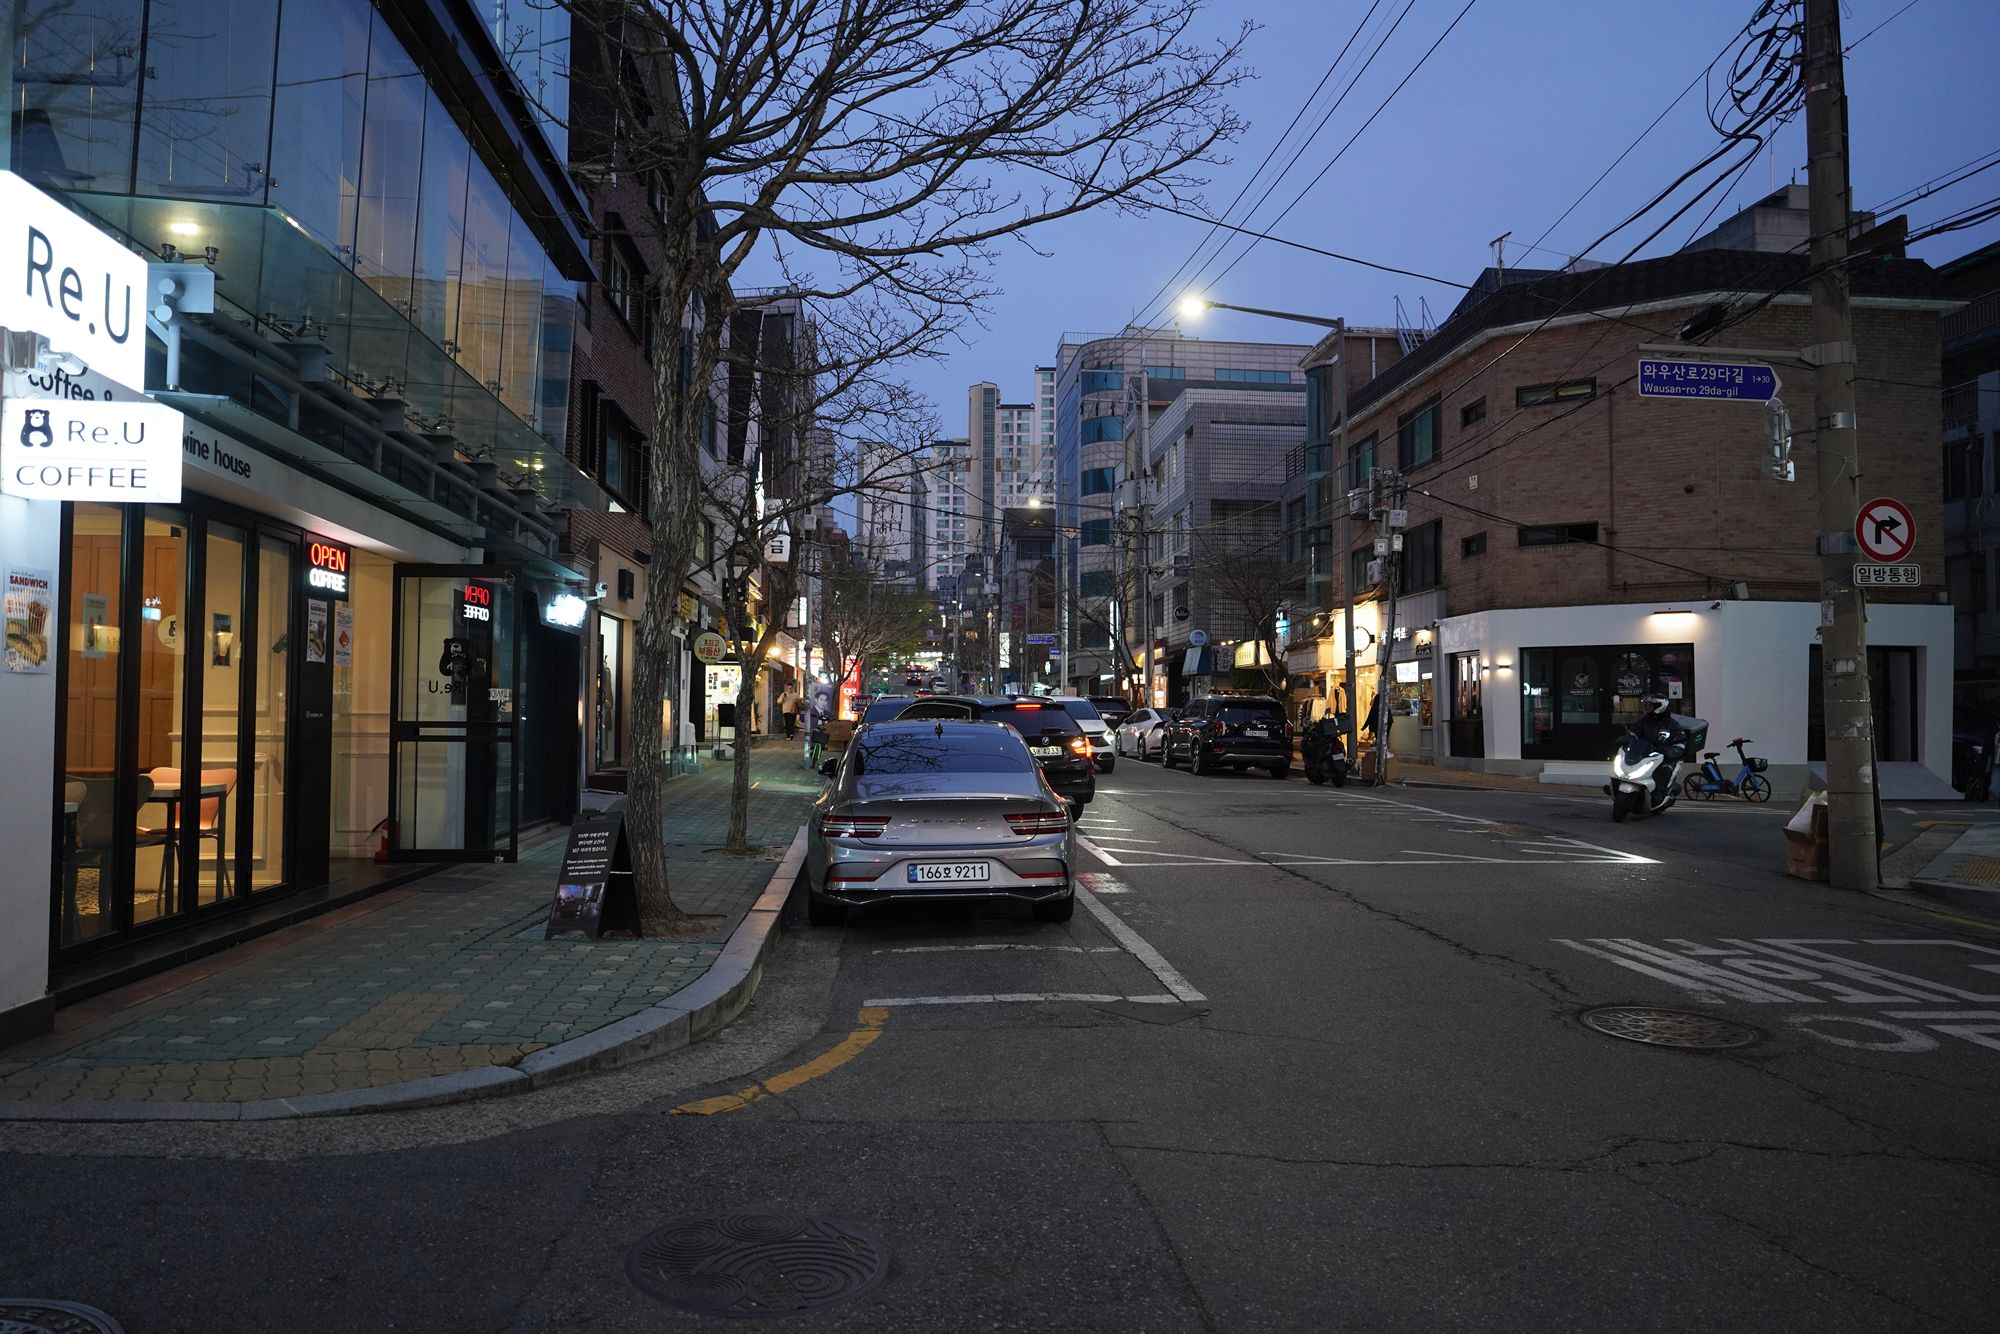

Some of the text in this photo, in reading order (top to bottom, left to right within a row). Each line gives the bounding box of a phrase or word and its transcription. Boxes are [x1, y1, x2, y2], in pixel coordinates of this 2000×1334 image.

[26, 224, 131, 345] Re.U
[1643, 364, 1744, 384] 와우산로29다길
[1643, 382, 1738, 397] Wausan-ro 29da-gil
[67, 419, 146, 446] Re.U
[213, 440, 251, 479] house
[16, 465, 148, 489] COFFEE
[311, 543, 346, 572] OPEN
[9, 575, 48, 590] SANDWICH
[309, 567, 346, 592] COFFEE
[1858, 567, 1917, 583] 일방통행
[919, 865, 985, 879] 166호 9211
